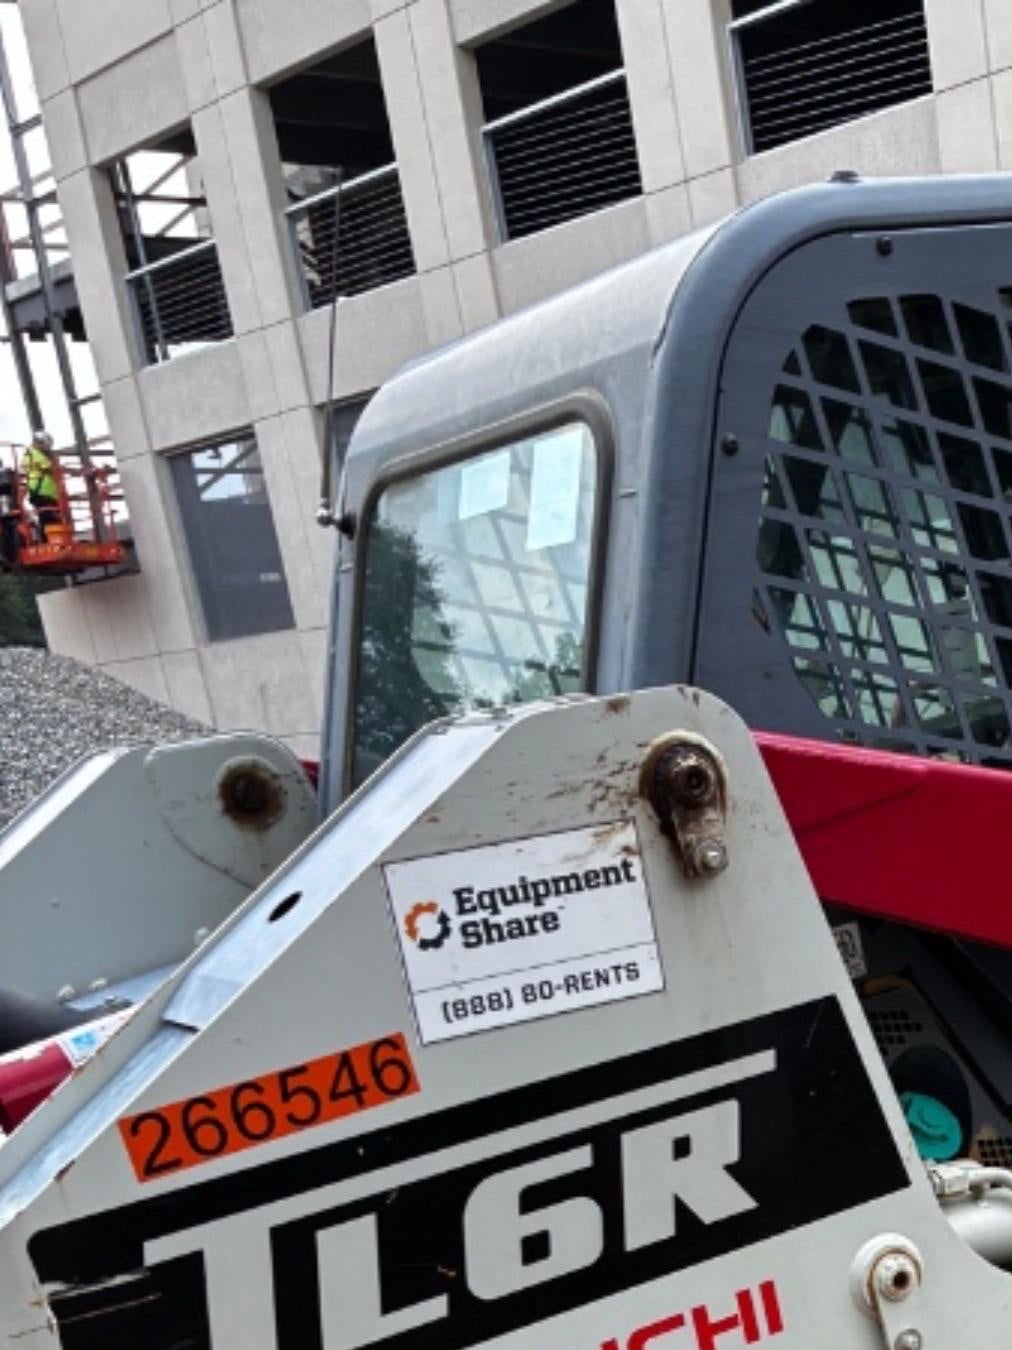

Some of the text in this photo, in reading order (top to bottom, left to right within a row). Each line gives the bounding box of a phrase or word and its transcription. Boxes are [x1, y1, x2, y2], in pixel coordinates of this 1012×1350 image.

[452, 857, 637, 917] Equipment
[461, 908, 560, 949] Share
[441, 962, 641, 1024] (888) 80-RENTS
[130, 1037, 413, 1178] 266546
